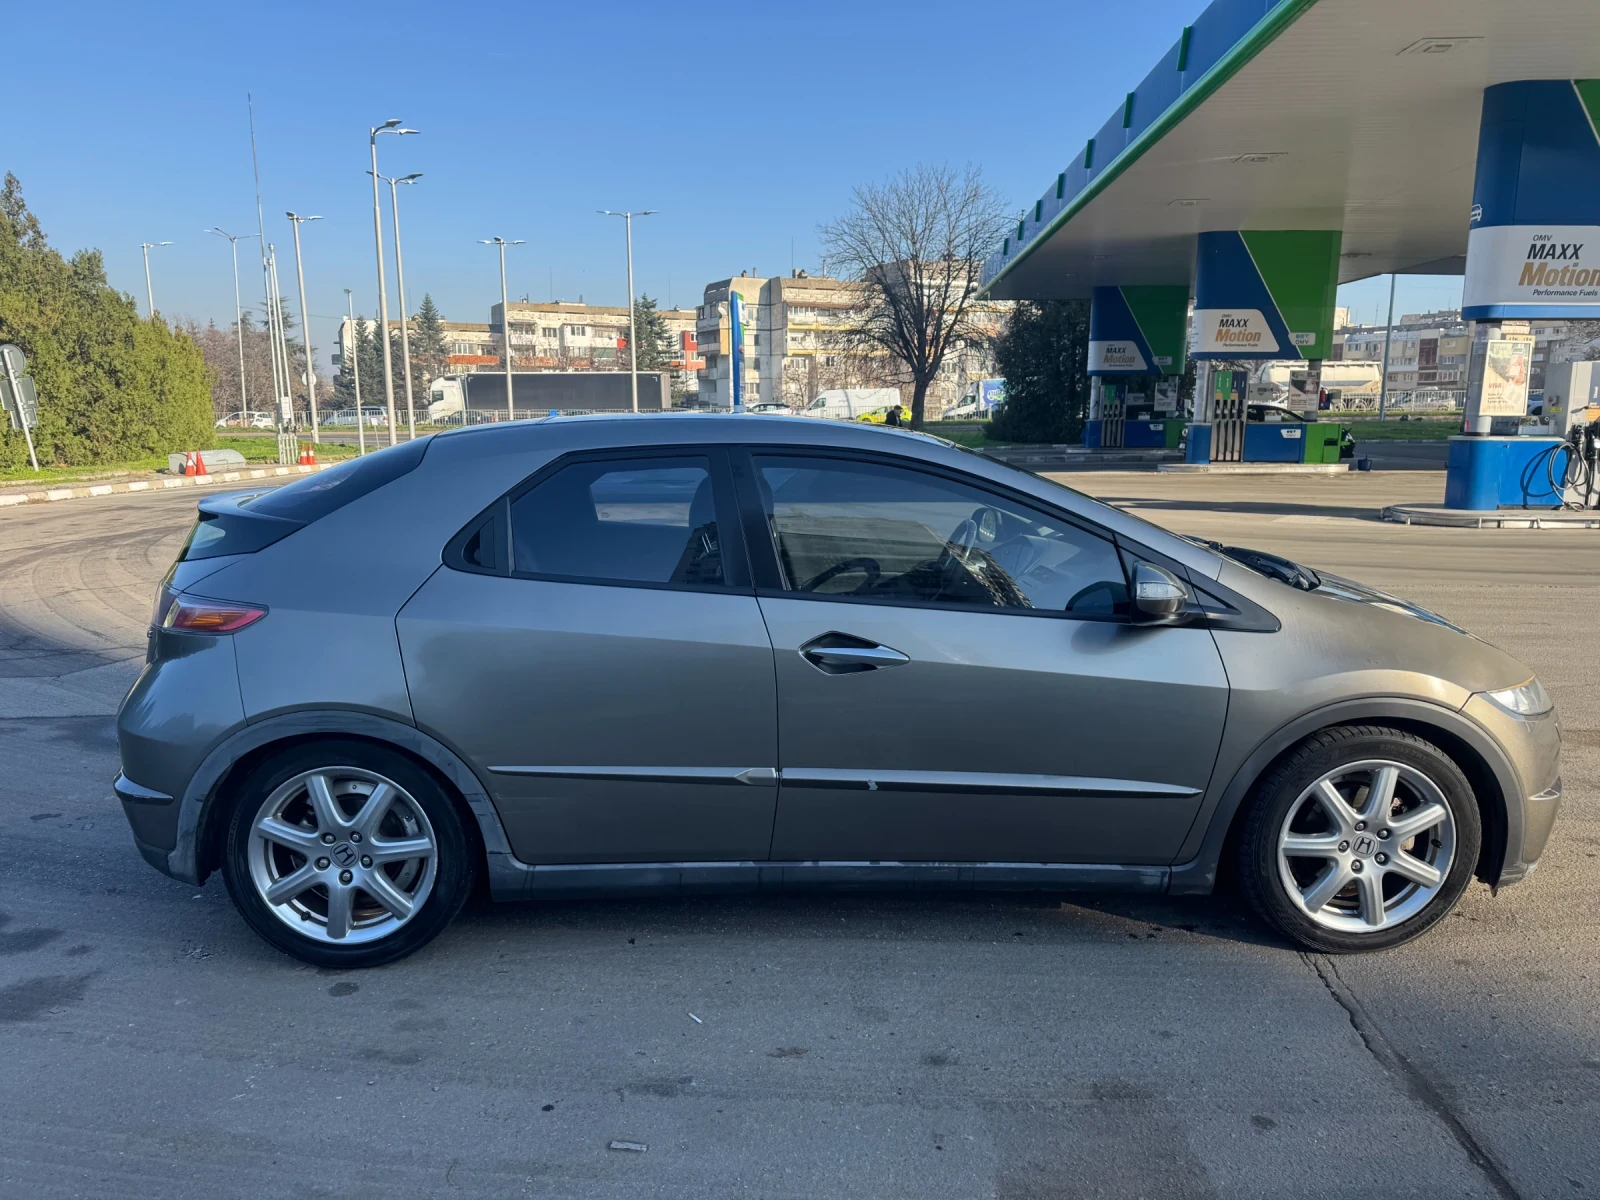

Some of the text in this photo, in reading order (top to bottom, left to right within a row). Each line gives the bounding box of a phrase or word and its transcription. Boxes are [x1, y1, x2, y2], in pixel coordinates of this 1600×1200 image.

[1532, 234, 1553, 242] OMV
[1526, 243, 1585, 260] MAXX
[1518, 262, 1600, 287] Motion
[1532, 289, 1578, 297] Performance
[1218, 318, 1249, 328] MAXX
[1215, 328, 1261, 342] Motion
[1103, 353, 1135, 364] Motion
